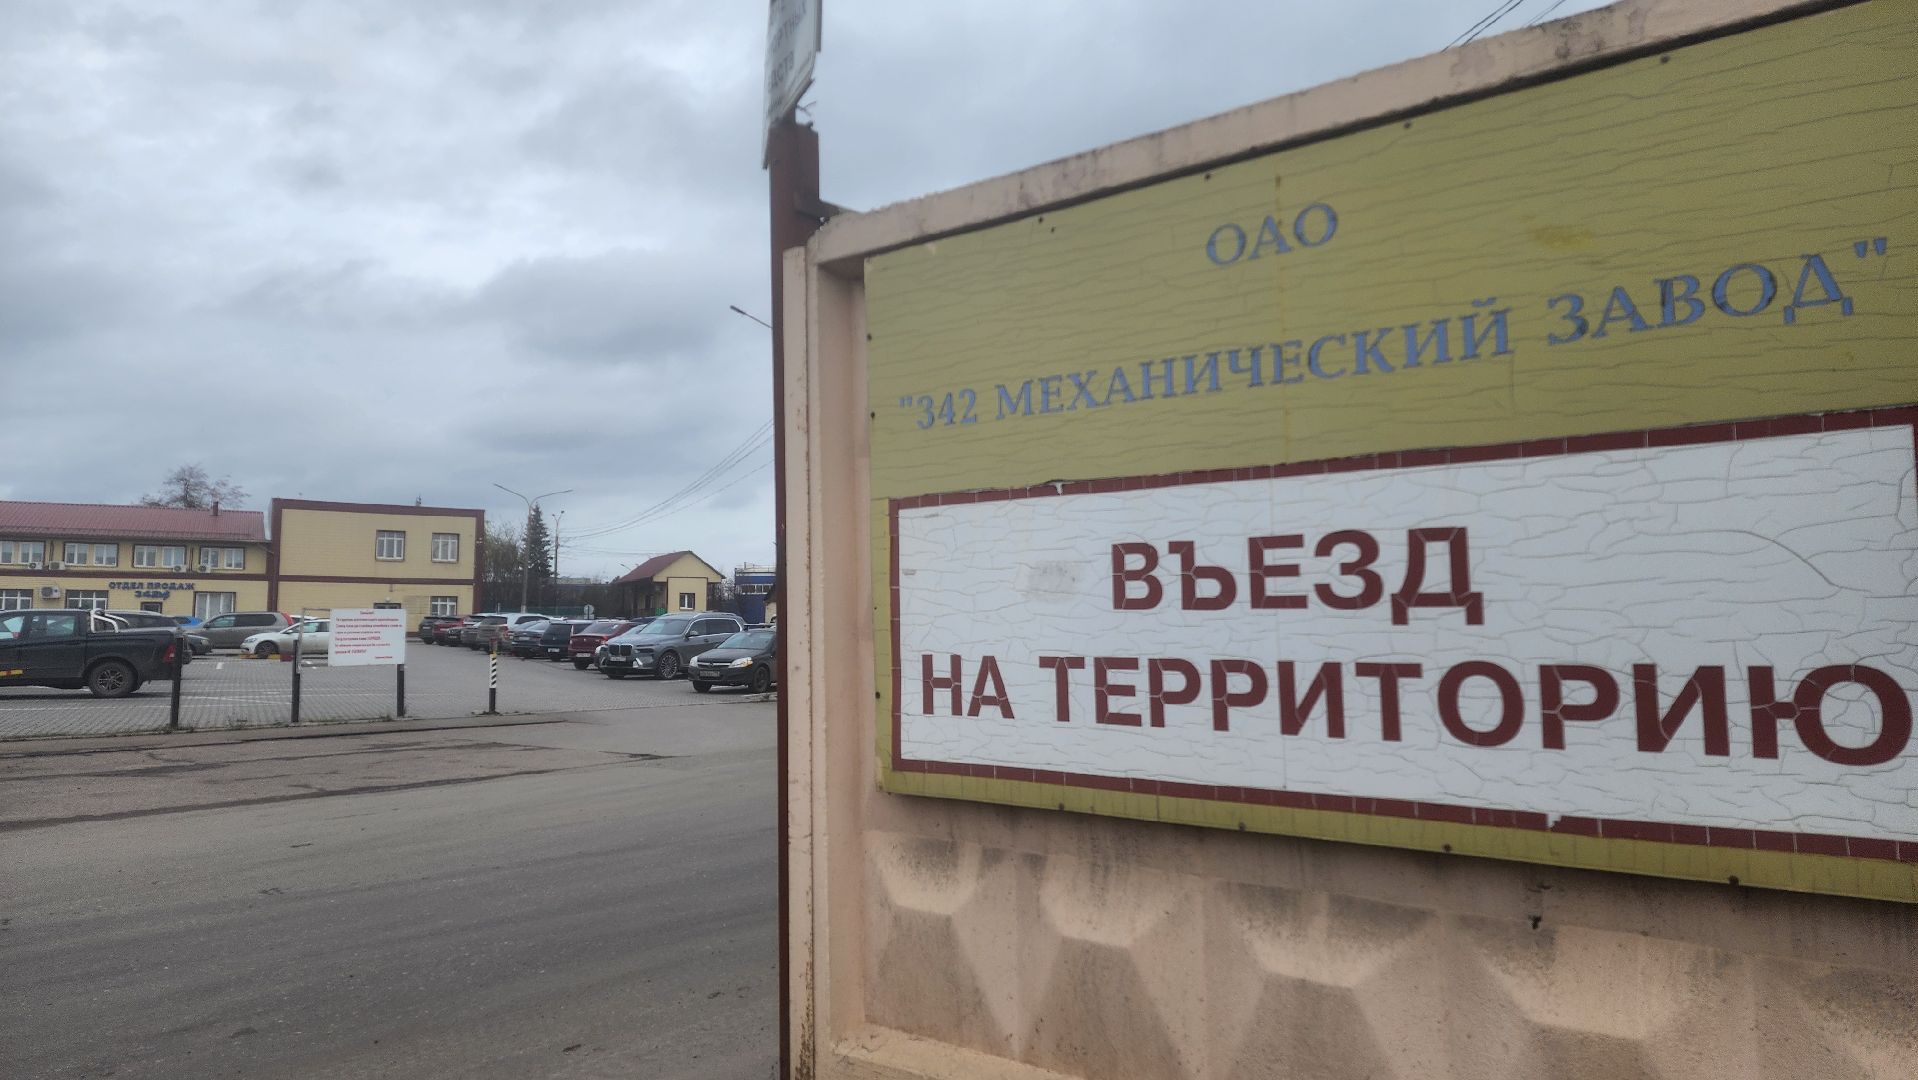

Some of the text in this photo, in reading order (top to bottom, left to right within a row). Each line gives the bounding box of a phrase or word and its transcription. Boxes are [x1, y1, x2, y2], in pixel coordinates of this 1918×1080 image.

[1206, 204, 1339, 266] ОАО
[898, 238, 1889, 430] "342 МЕХАНИЧЕСКИЙ ЗАВОД"
[108, 581, 194, 591] ОТДЕЛ ПРОДАЖ
[1112, 527, 1484, 626] ВЪЕЗД
[922, 655, 1914, 766] НА ТЕРРИТОРИЮ
